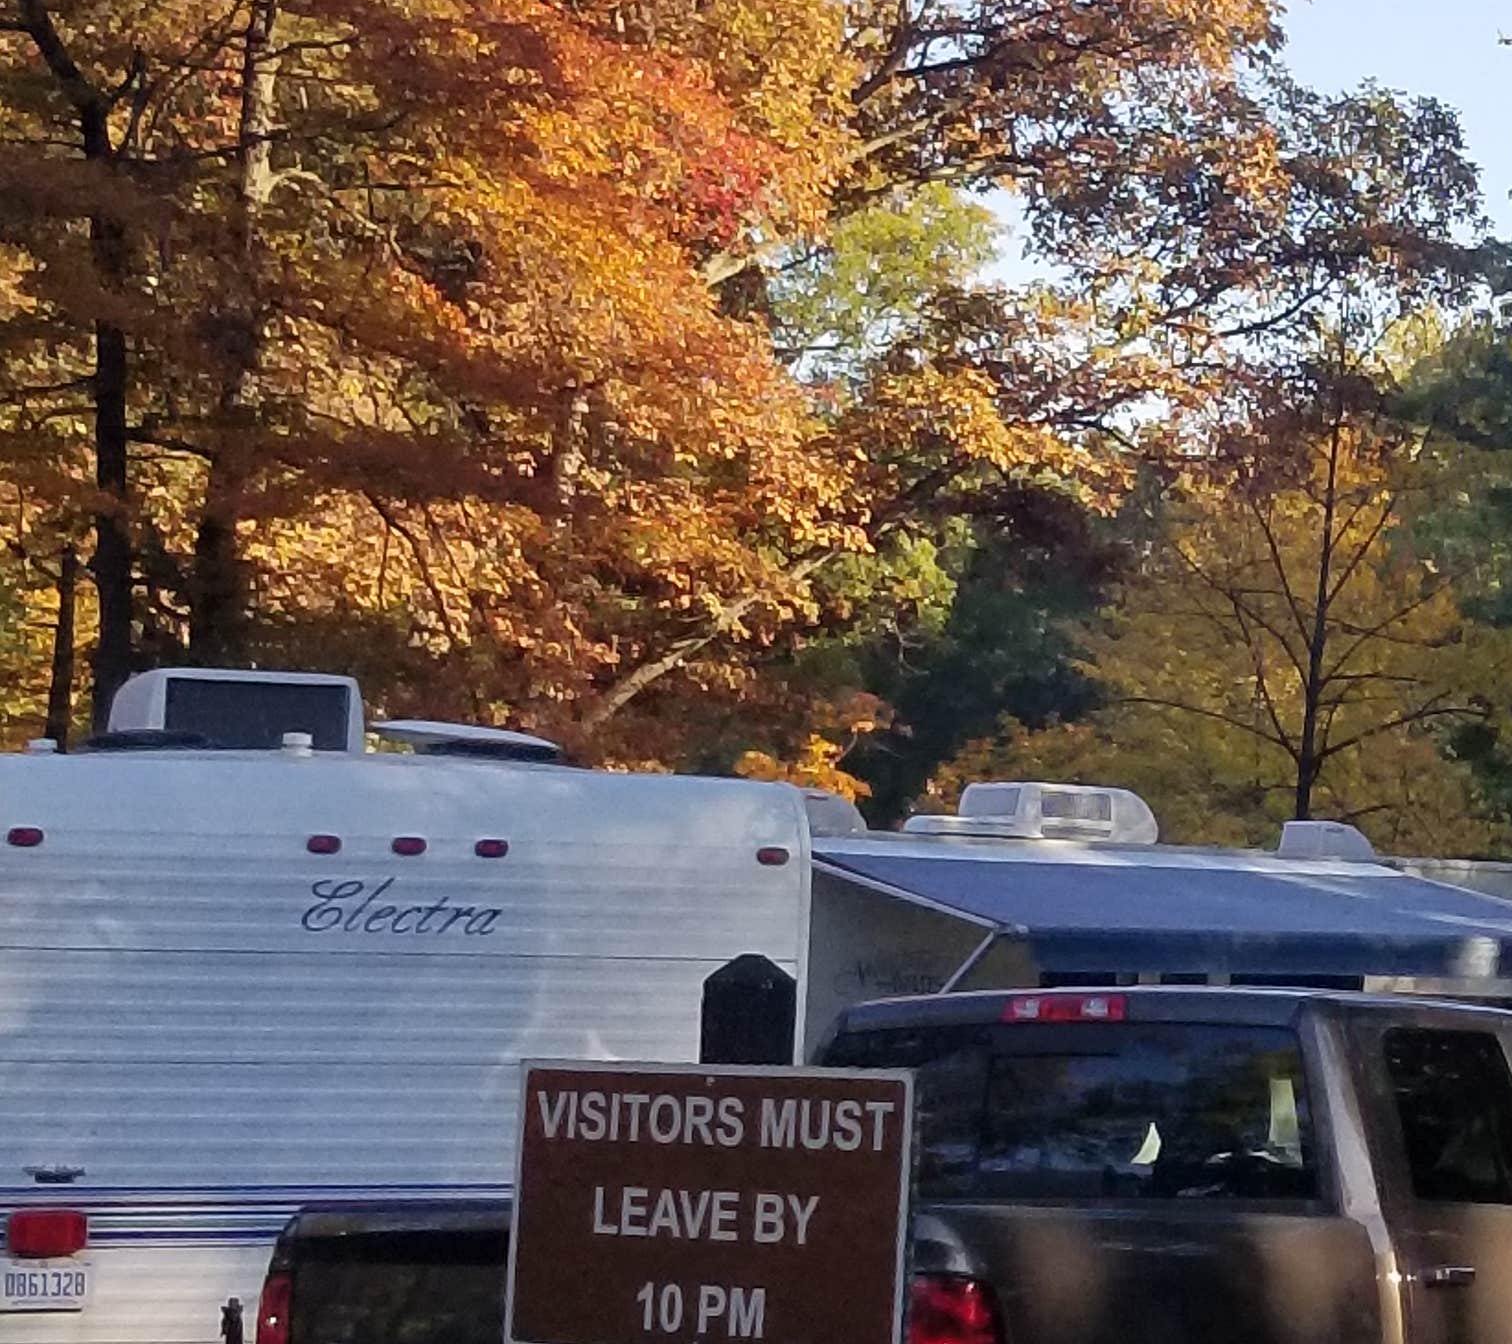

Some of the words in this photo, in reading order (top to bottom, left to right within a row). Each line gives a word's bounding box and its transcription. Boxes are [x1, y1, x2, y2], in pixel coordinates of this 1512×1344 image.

[301, 877, 502, 936] Electra
[537, 1091, 745, 1148] VISITORS
[760, 1098, 894, 1151] MUST
[593, 1186, 740, 1242] LEAVE
[753, 1193, 820, 1245] BY
[636, 1281, 683, 1334] 10
[698, 1285, 766, 1339] PM
